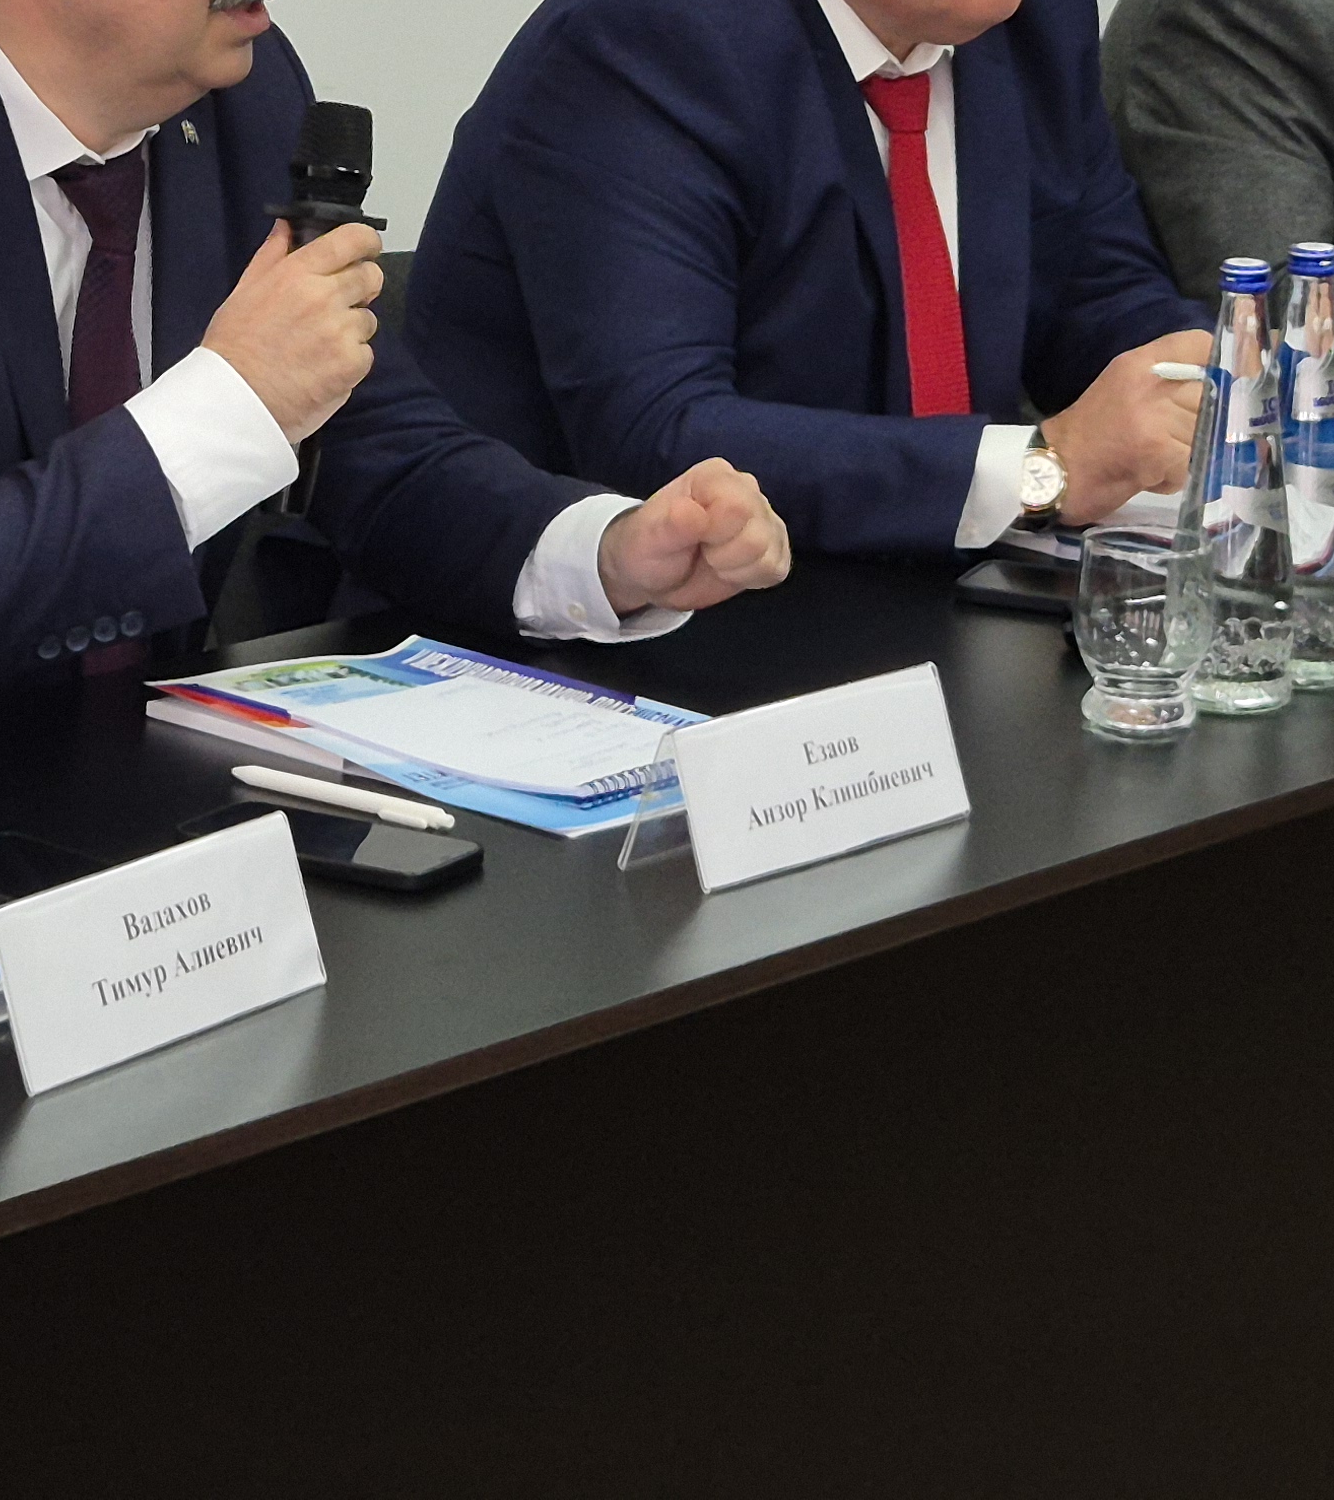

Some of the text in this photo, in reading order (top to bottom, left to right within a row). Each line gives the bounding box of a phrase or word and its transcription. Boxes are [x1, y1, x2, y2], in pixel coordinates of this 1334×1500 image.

[802, 735, 859, 767] Езаов
[747, 760, 935, 832] Анзор Клишбиевич
[121, 891, 213, 942] Вадахов
[91, 925, 266, 1008] Тимур Алиевич
